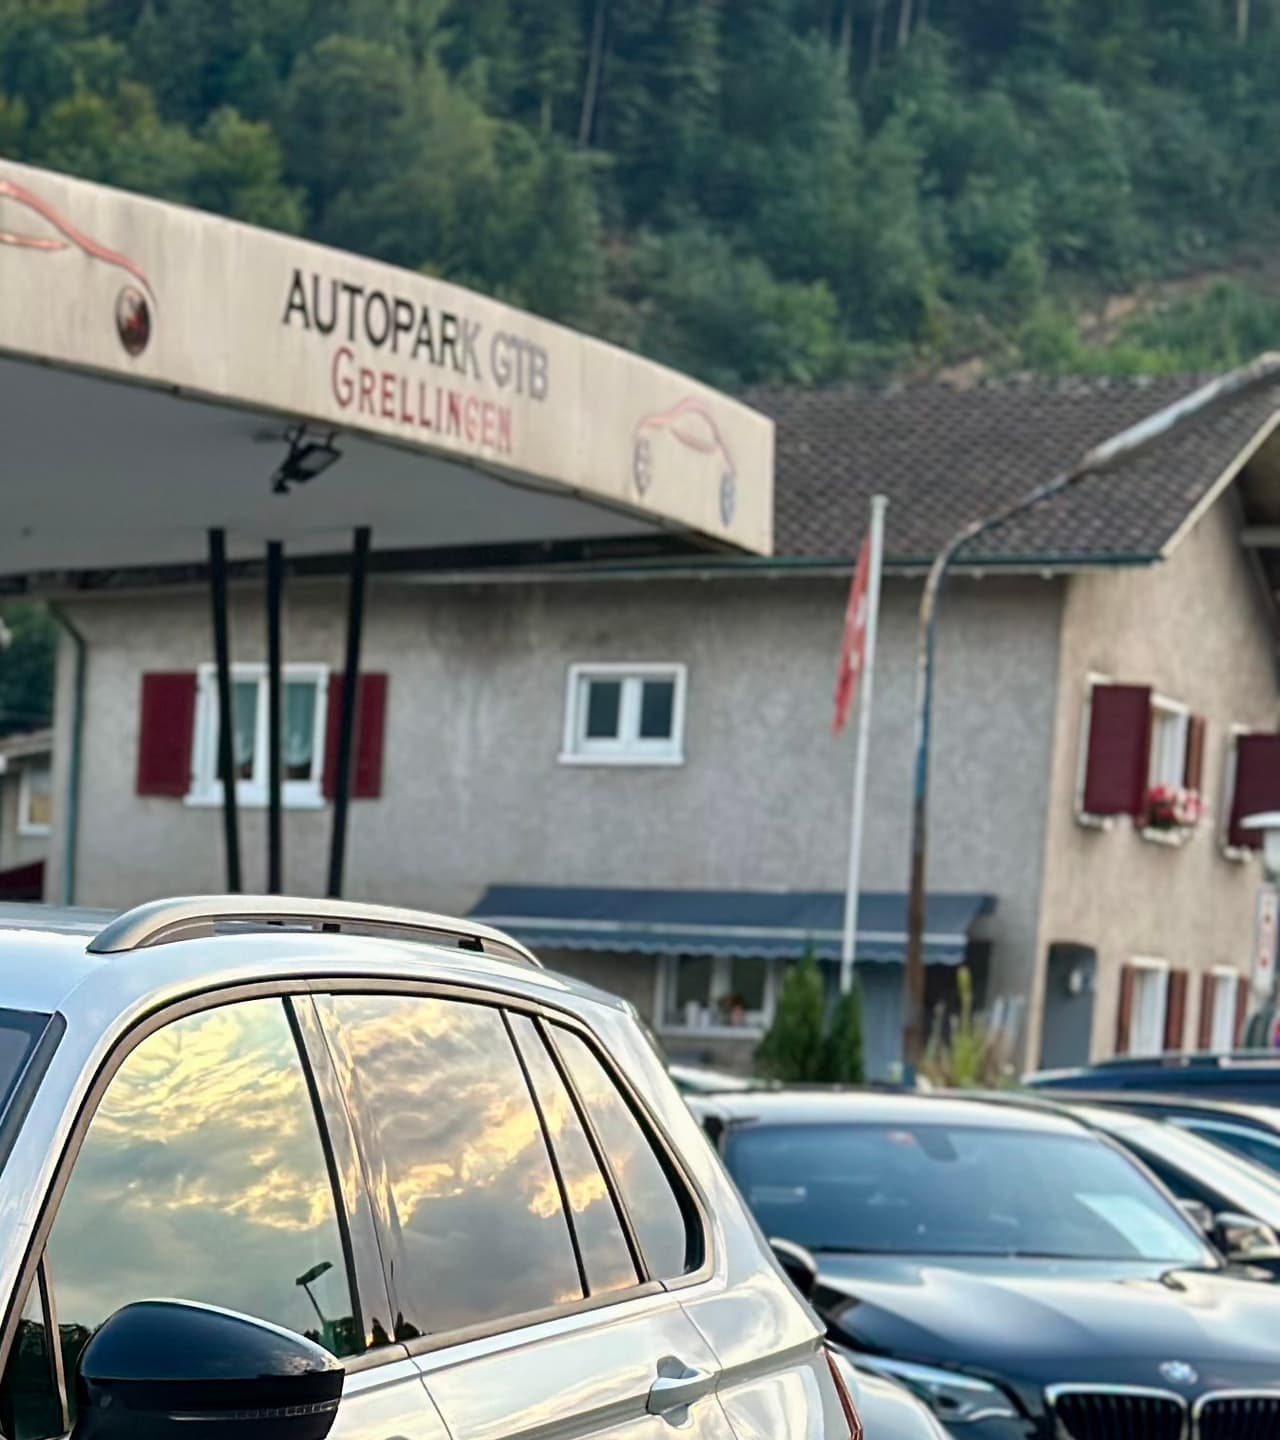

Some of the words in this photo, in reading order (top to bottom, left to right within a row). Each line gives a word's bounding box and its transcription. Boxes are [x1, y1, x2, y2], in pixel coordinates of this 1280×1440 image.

[282, 268, 483, 381] AUTOPARK
[490, 331, 550, 402] GTB
[331, 346, 513, 455] GRELLINGEN
